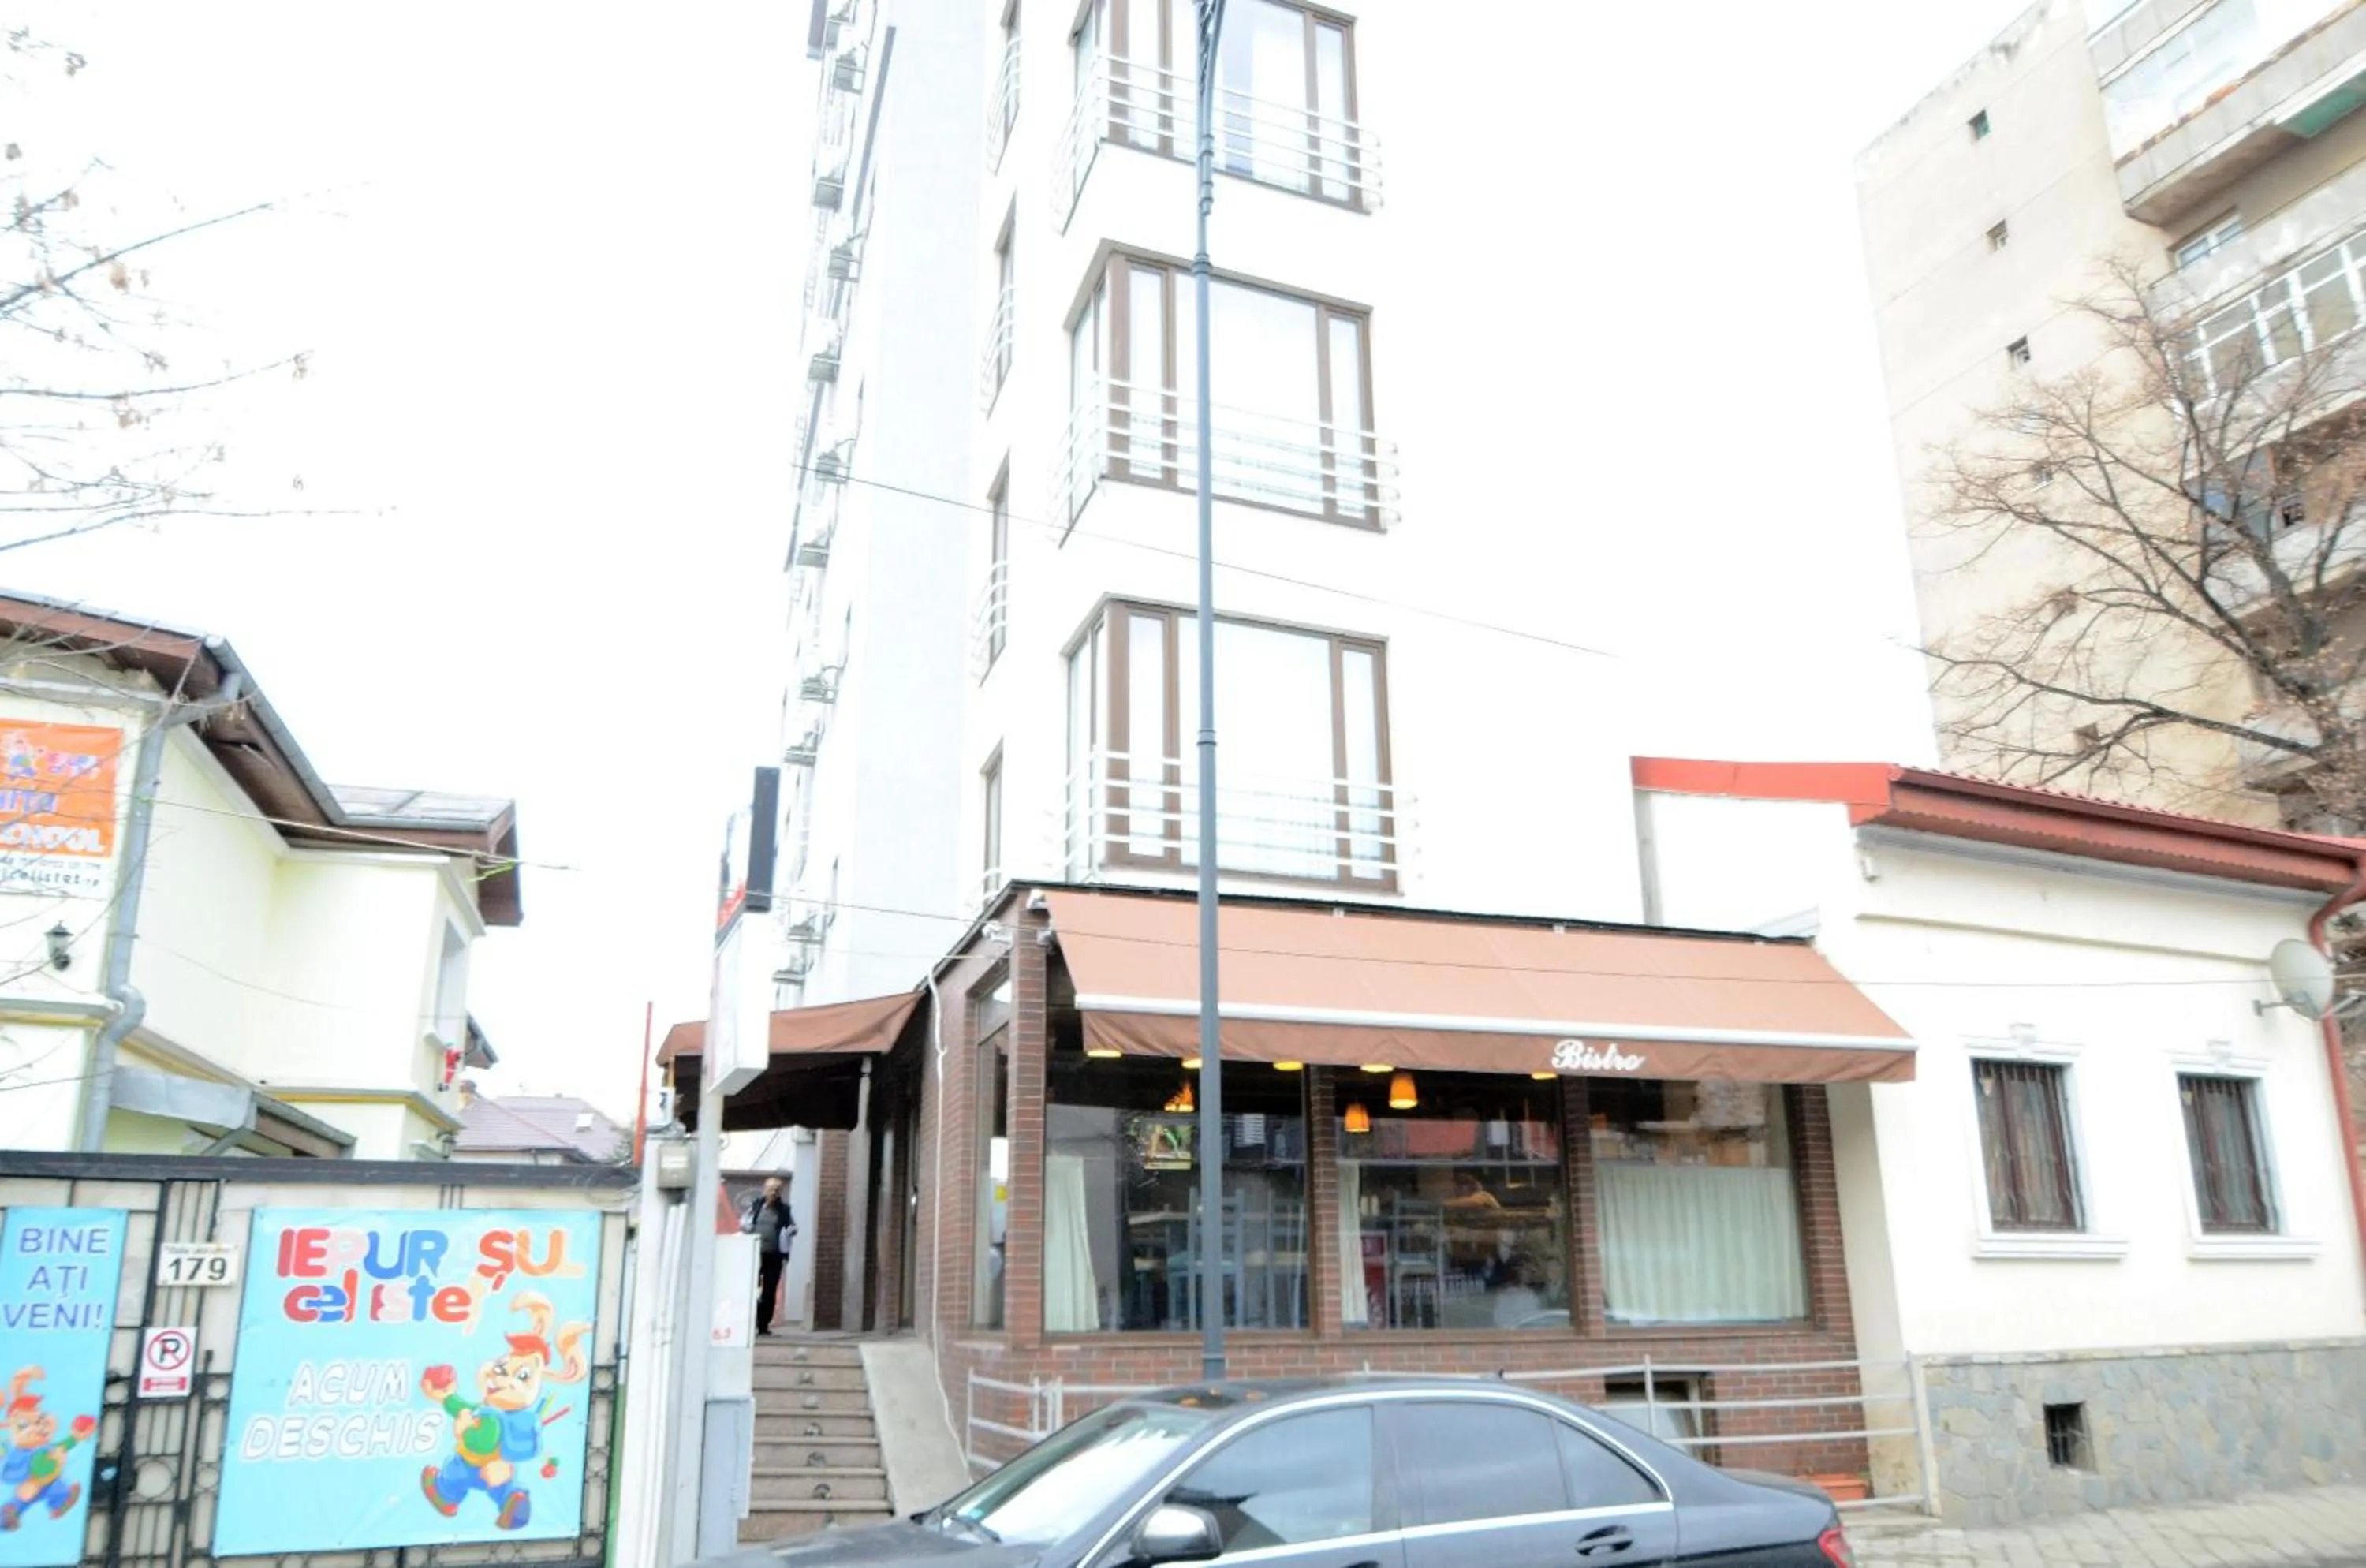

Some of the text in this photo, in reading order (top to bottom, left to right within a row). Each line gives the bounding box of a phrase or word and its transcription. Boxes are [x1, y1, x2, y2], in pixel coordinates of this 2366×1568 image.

[1551, 1038, 1647, 1070] Bistro
[20, 1228, 110, 1253] BINE
[167, 1256, 226, 1281] 179
[3, 1303, 103, 1329] VENI!
[288, 1363, 409, 1406] ACUM
[242, 1412, 444, 1460] DESCHIS
